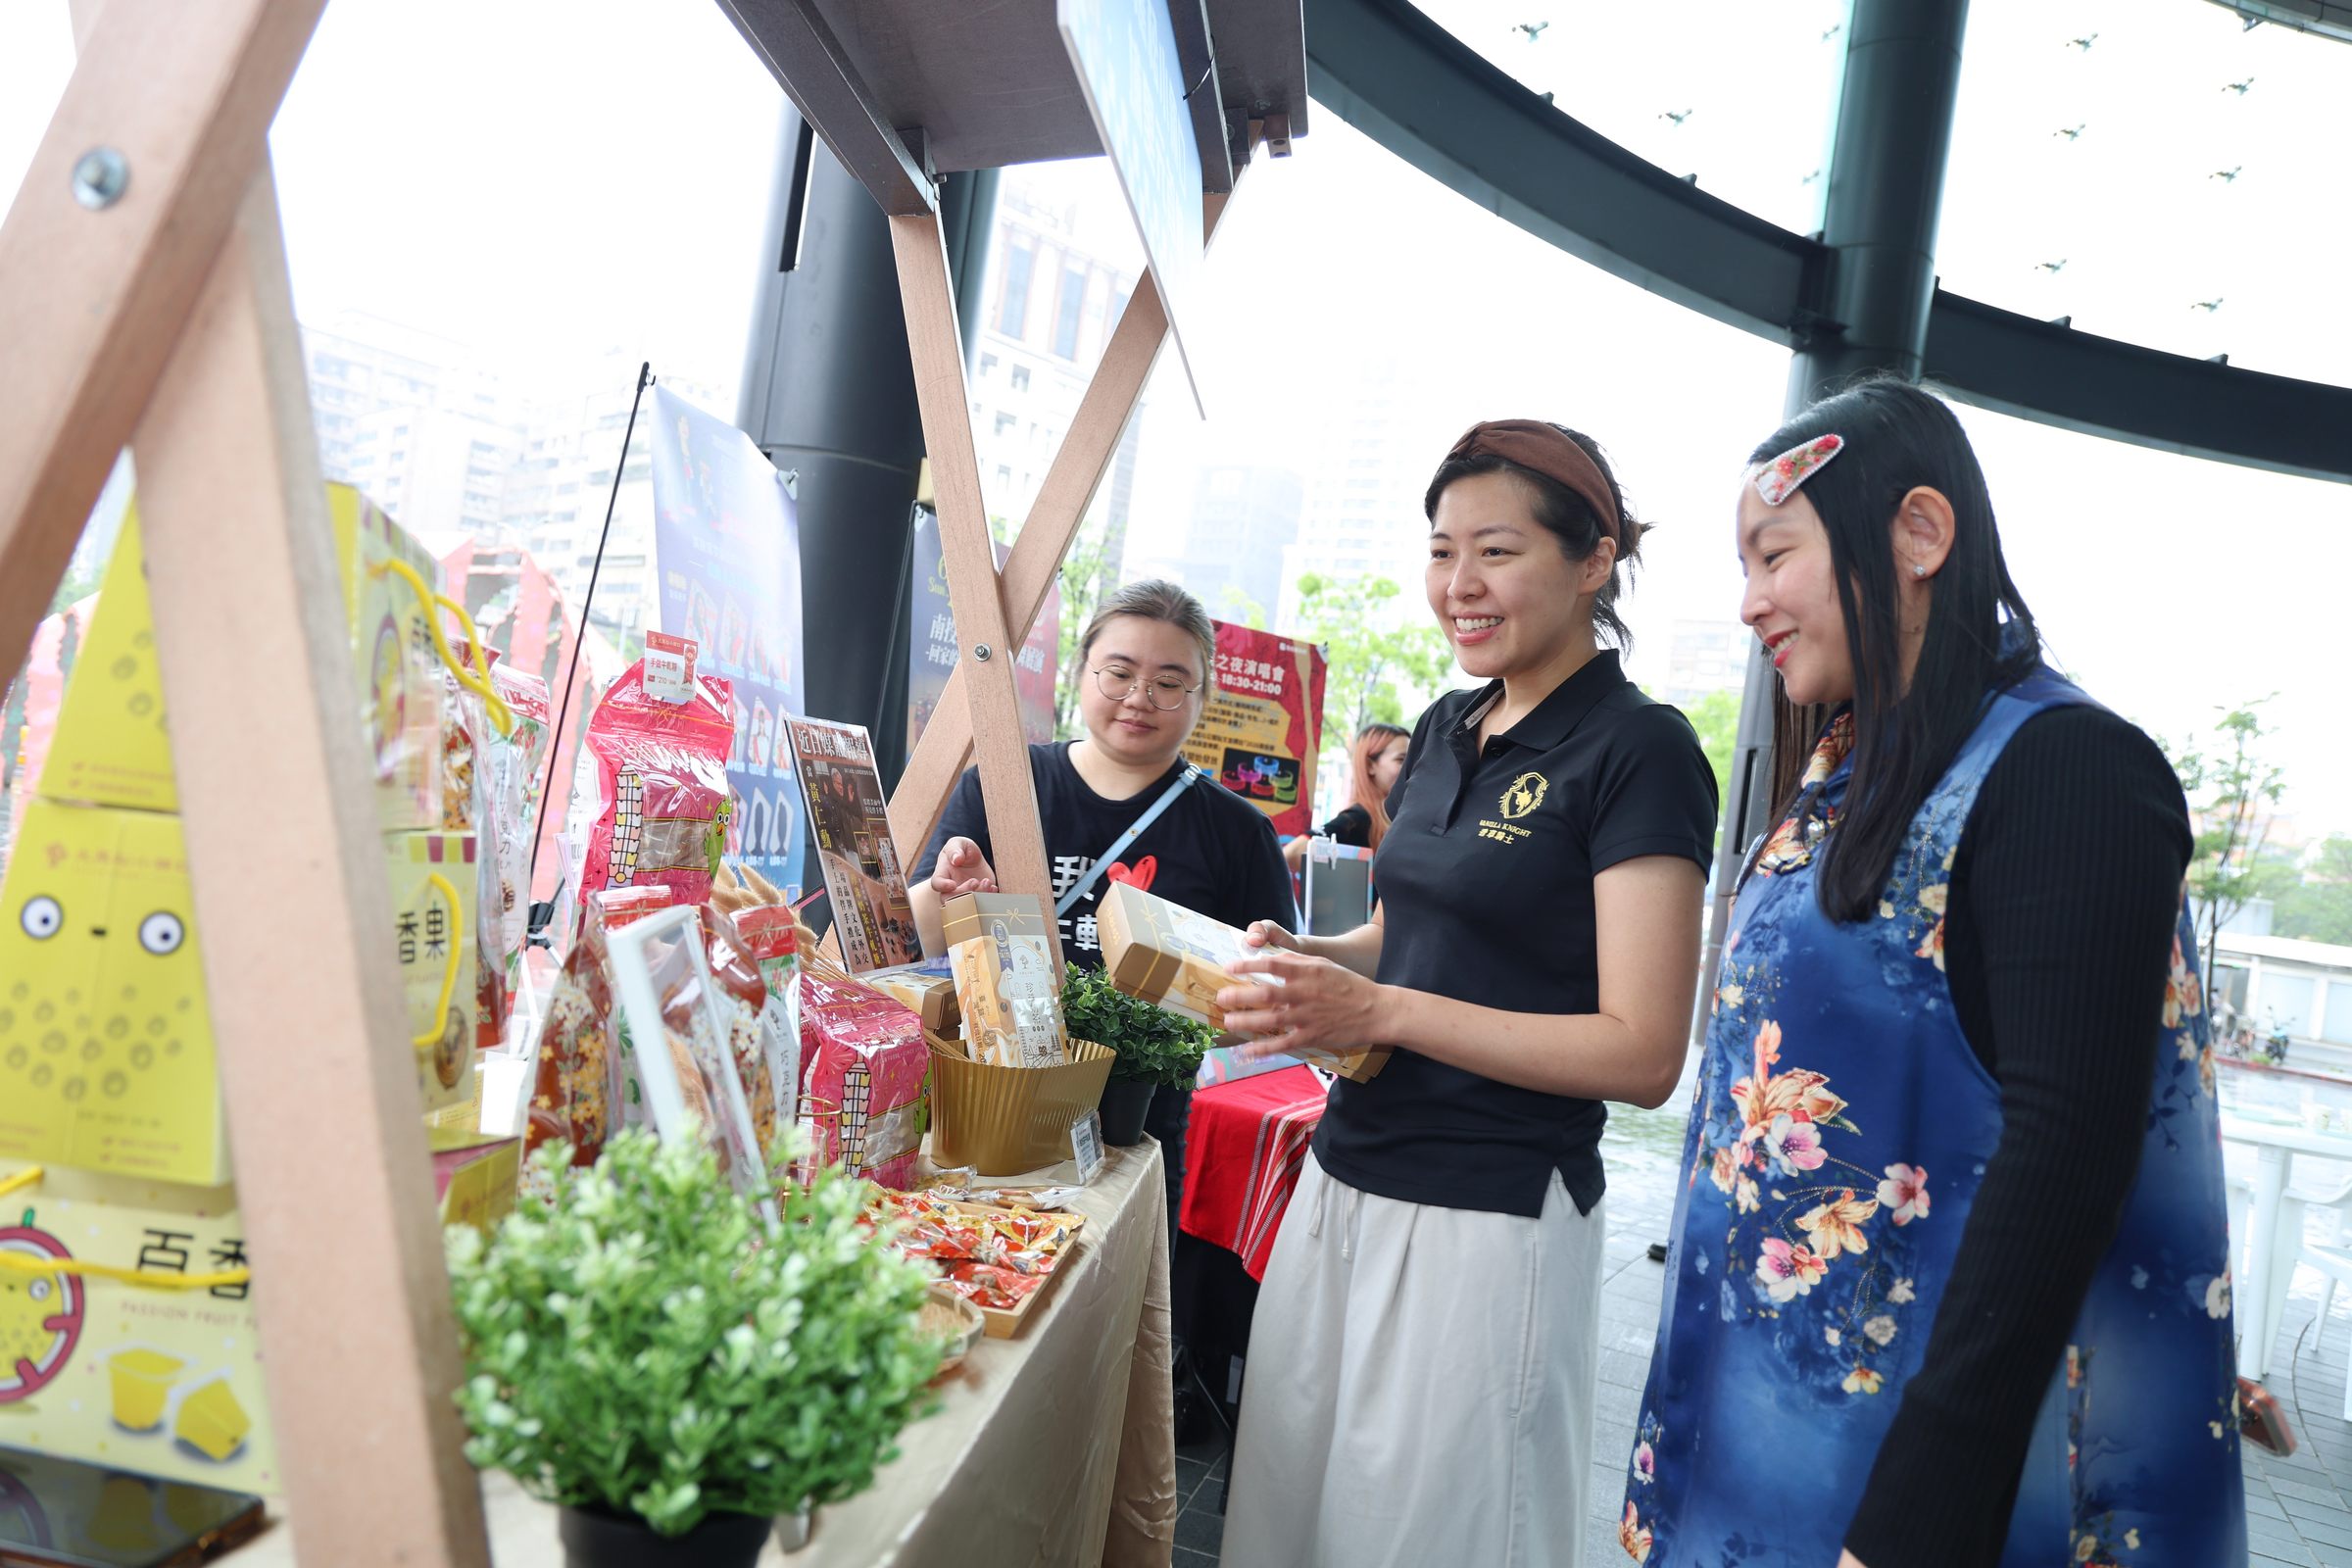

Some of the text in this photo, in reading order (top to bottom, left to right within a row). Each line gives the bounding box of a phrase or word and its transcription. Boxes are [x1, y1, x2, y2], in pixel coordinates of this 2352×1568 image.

[1209, 653, 1285, 683] 之夜演唱會
[1221, 673, 1282, 695] 18:30-21:00
